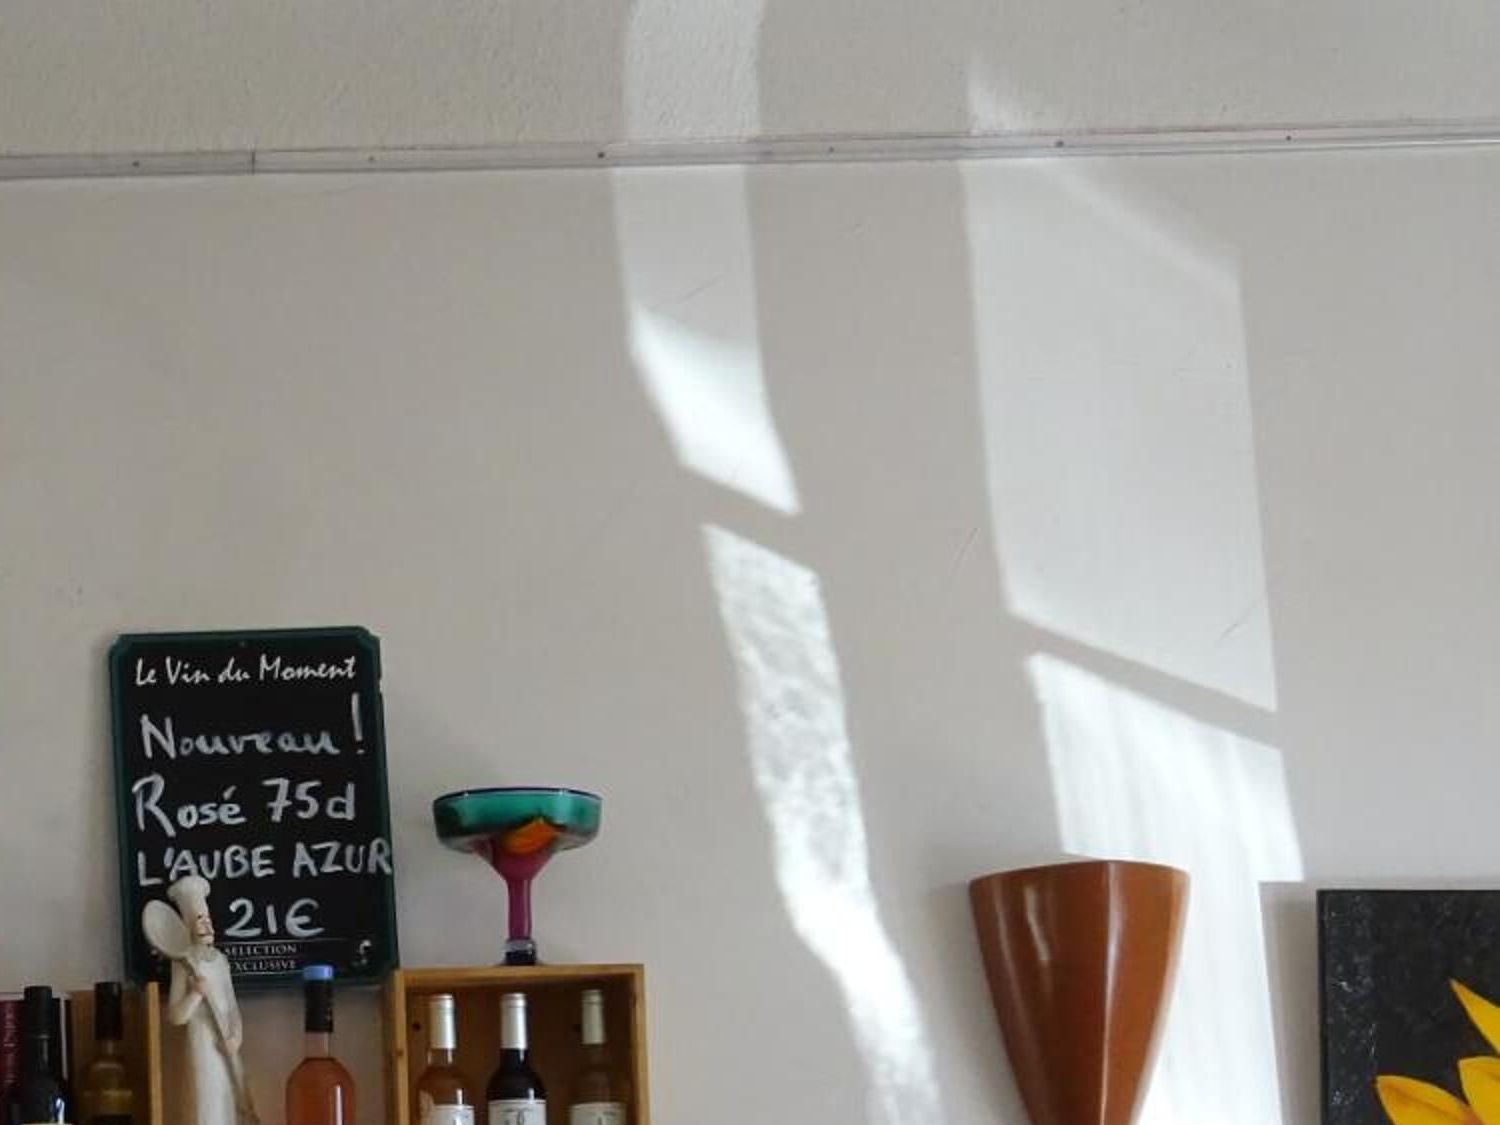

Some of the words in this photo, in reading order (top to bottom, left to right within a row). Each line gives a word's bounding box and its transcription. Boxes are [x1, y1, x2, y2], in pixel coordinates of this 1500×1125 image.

[164, 656, 210, 685] Vin
[217, 656, 250, 683] du
[259, 653, 356, 681] Moment
[132, 773, 247, 838] Rosé
[137, 845, 276, 887] L'AUBE
[291, 837, 393, 879] AZUR
[223, 898, 325, 938] 21€
